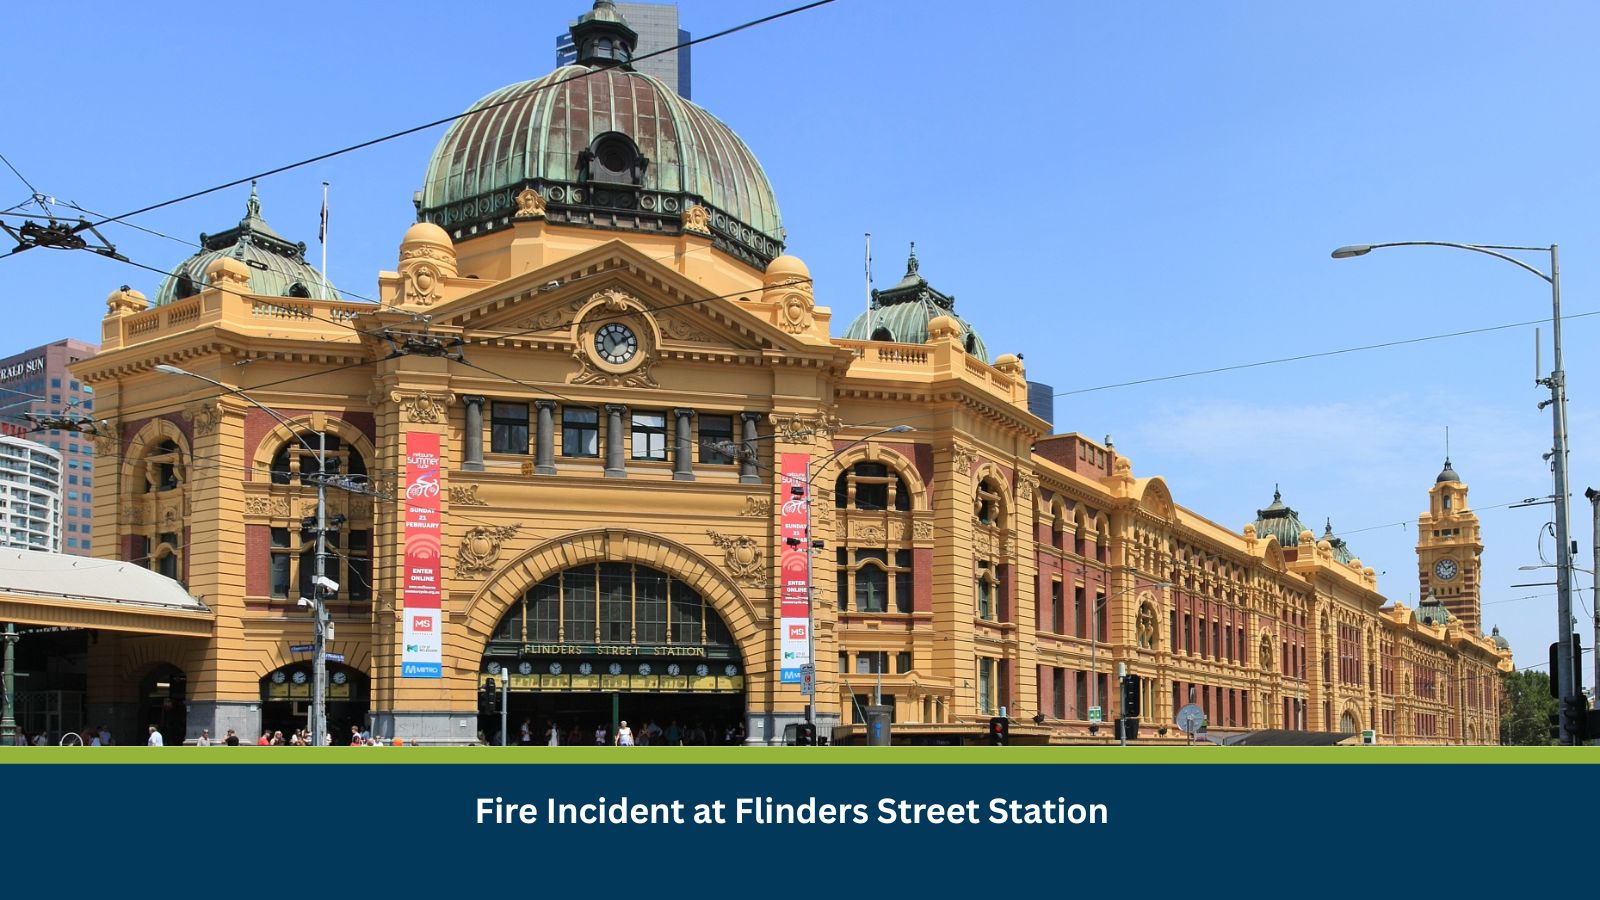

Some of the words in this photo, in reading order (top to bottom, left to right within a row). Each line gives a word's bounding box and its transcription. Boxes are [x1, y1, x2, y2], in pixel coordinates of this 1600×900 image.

[26, 357, 44, 372] SUN
[406, 521, 440, 529] FEBRUARY
[415, 620, 431, 628] MS
[791, 628, 805, 636] MS
[524, 644, 582, 655] FLINDERS
[597, 645, 640, 656] STREET
[654, 646, 705, 656] STATION
